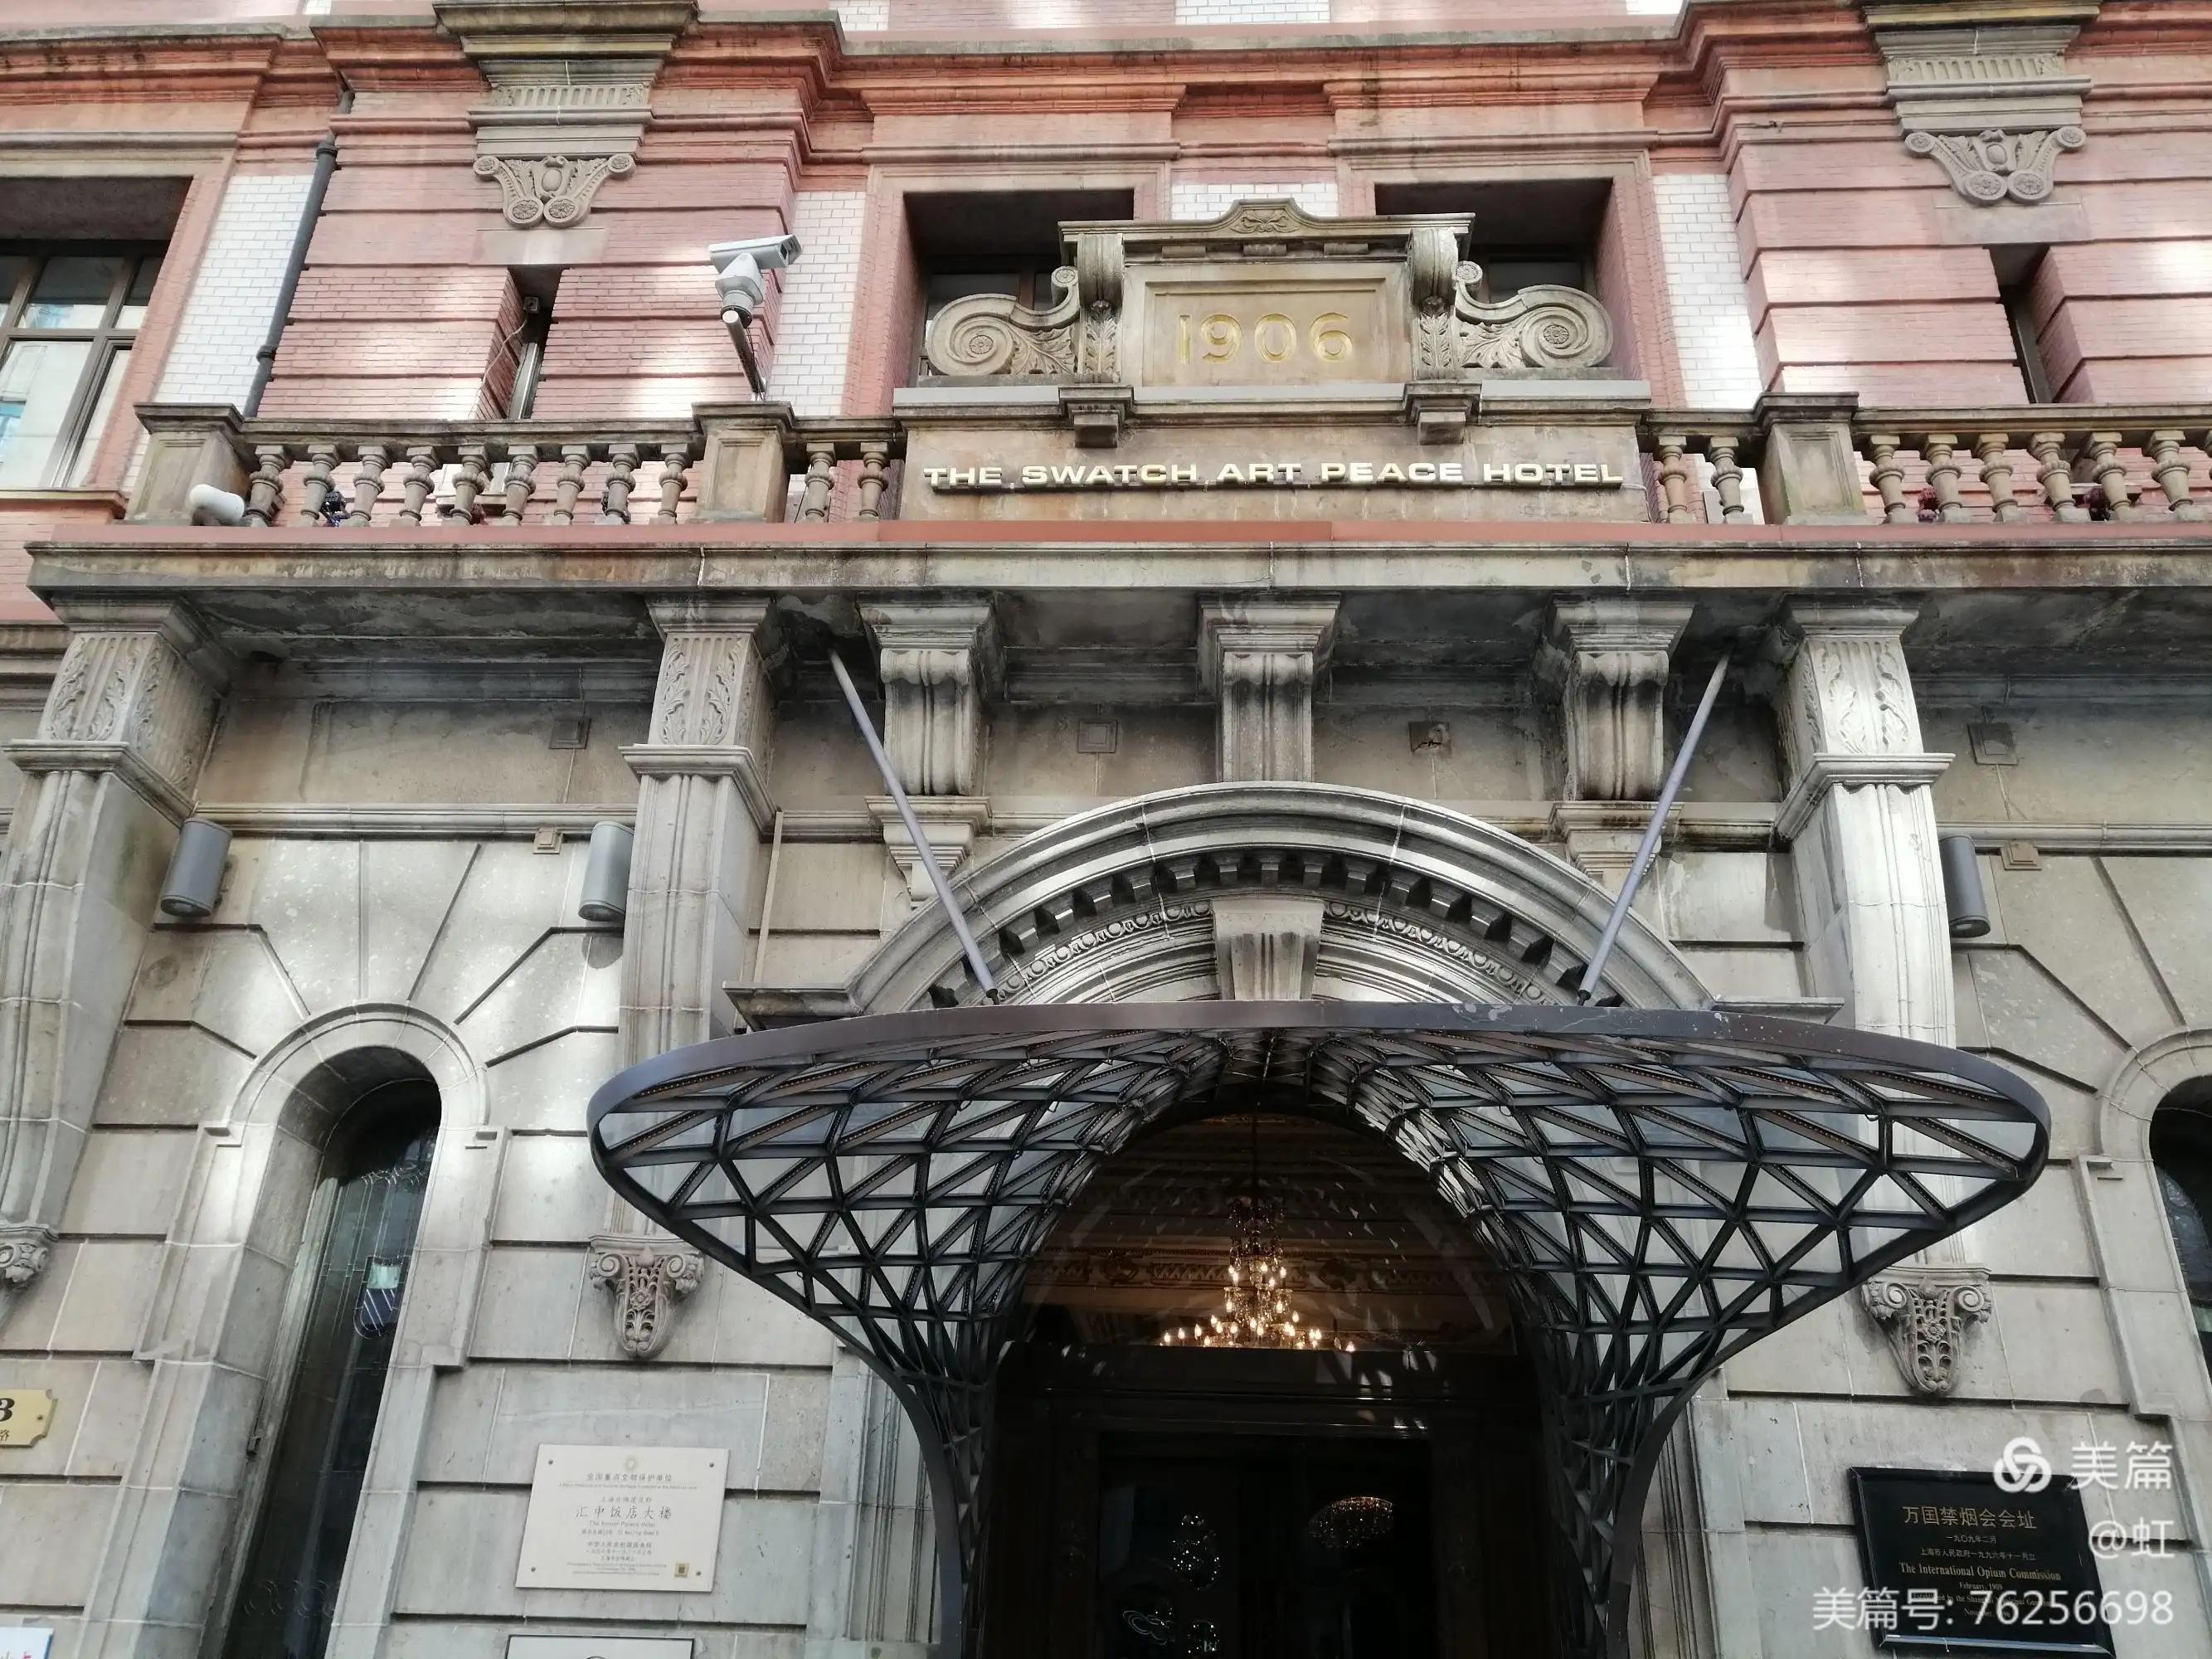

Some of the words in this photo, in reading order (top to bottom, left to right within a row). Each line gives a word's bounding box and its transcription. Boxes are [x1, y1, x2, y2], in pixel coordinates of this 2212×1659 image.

[1179, 312, 1354, 364] 1906
[923, 467, 1003, 489] THE
[1021, 464, 1198, 487] SWATCH
[1216, 462, 1302, 485] ART
[1320, 462, 1464, 484] PEACE
[1482, 462, 1624, 484] HOTEL
[575, 1505, 673, 1520] 汇中饭店大楼
[1901, 1506, 2038, 1530] 万国禁烟会会址
[1899, 1562, 1916, 1574] The
[1918, 1563, 1975, 1577] International
[1976, 1565, 2007, 1579] Opium
[2009, 1568, 2062, 1581] Commission
